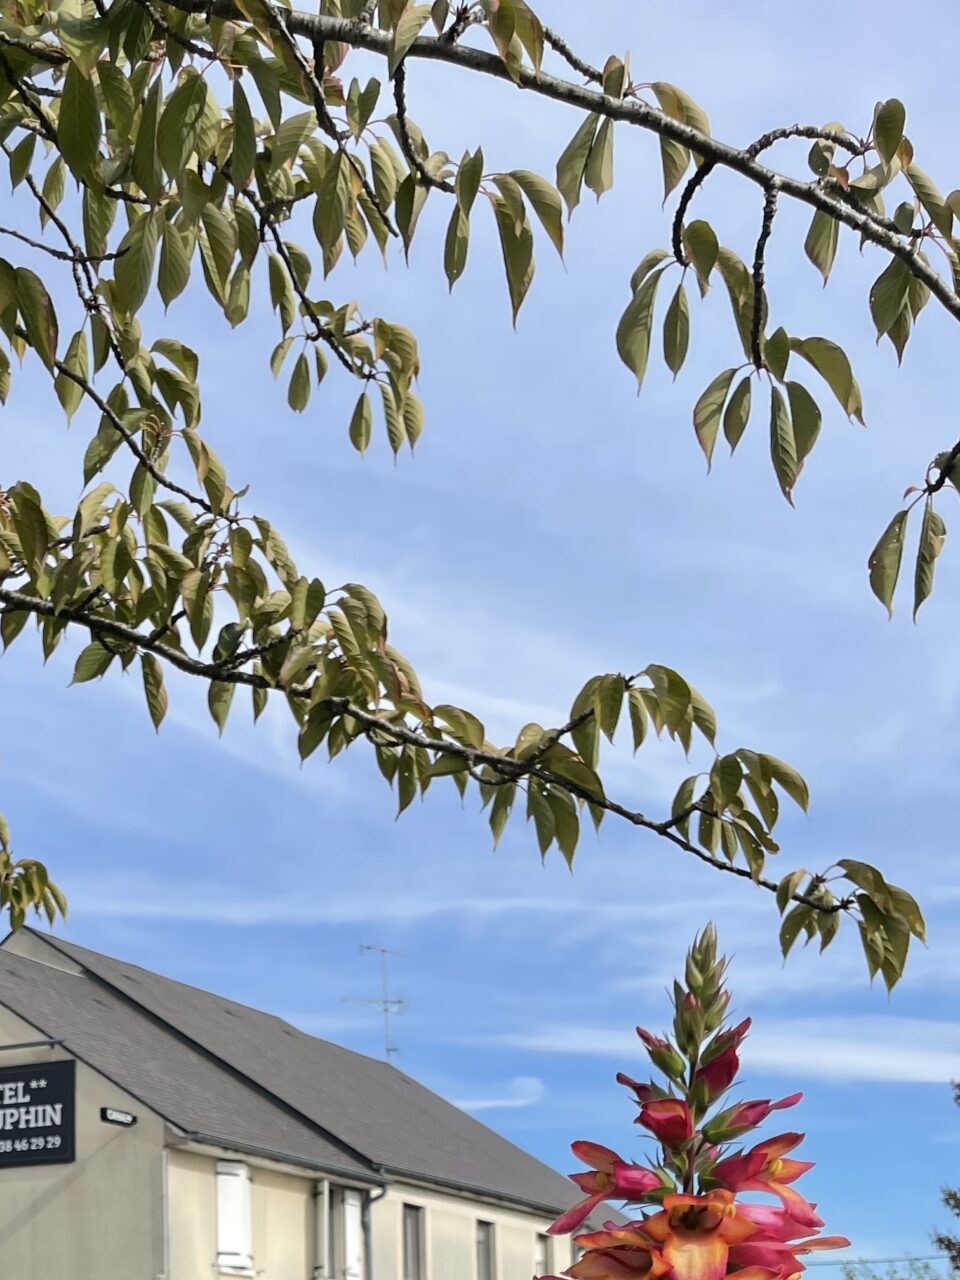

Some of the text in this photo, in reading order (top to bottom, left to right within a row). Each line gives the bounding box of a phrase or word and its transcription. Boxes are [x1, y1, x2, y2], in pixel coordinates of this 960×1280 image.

[13, 1137, 29, 1151] 46
[29, 1136, 45, 1150] 29
[45, 1134, 61, 1149] 29
